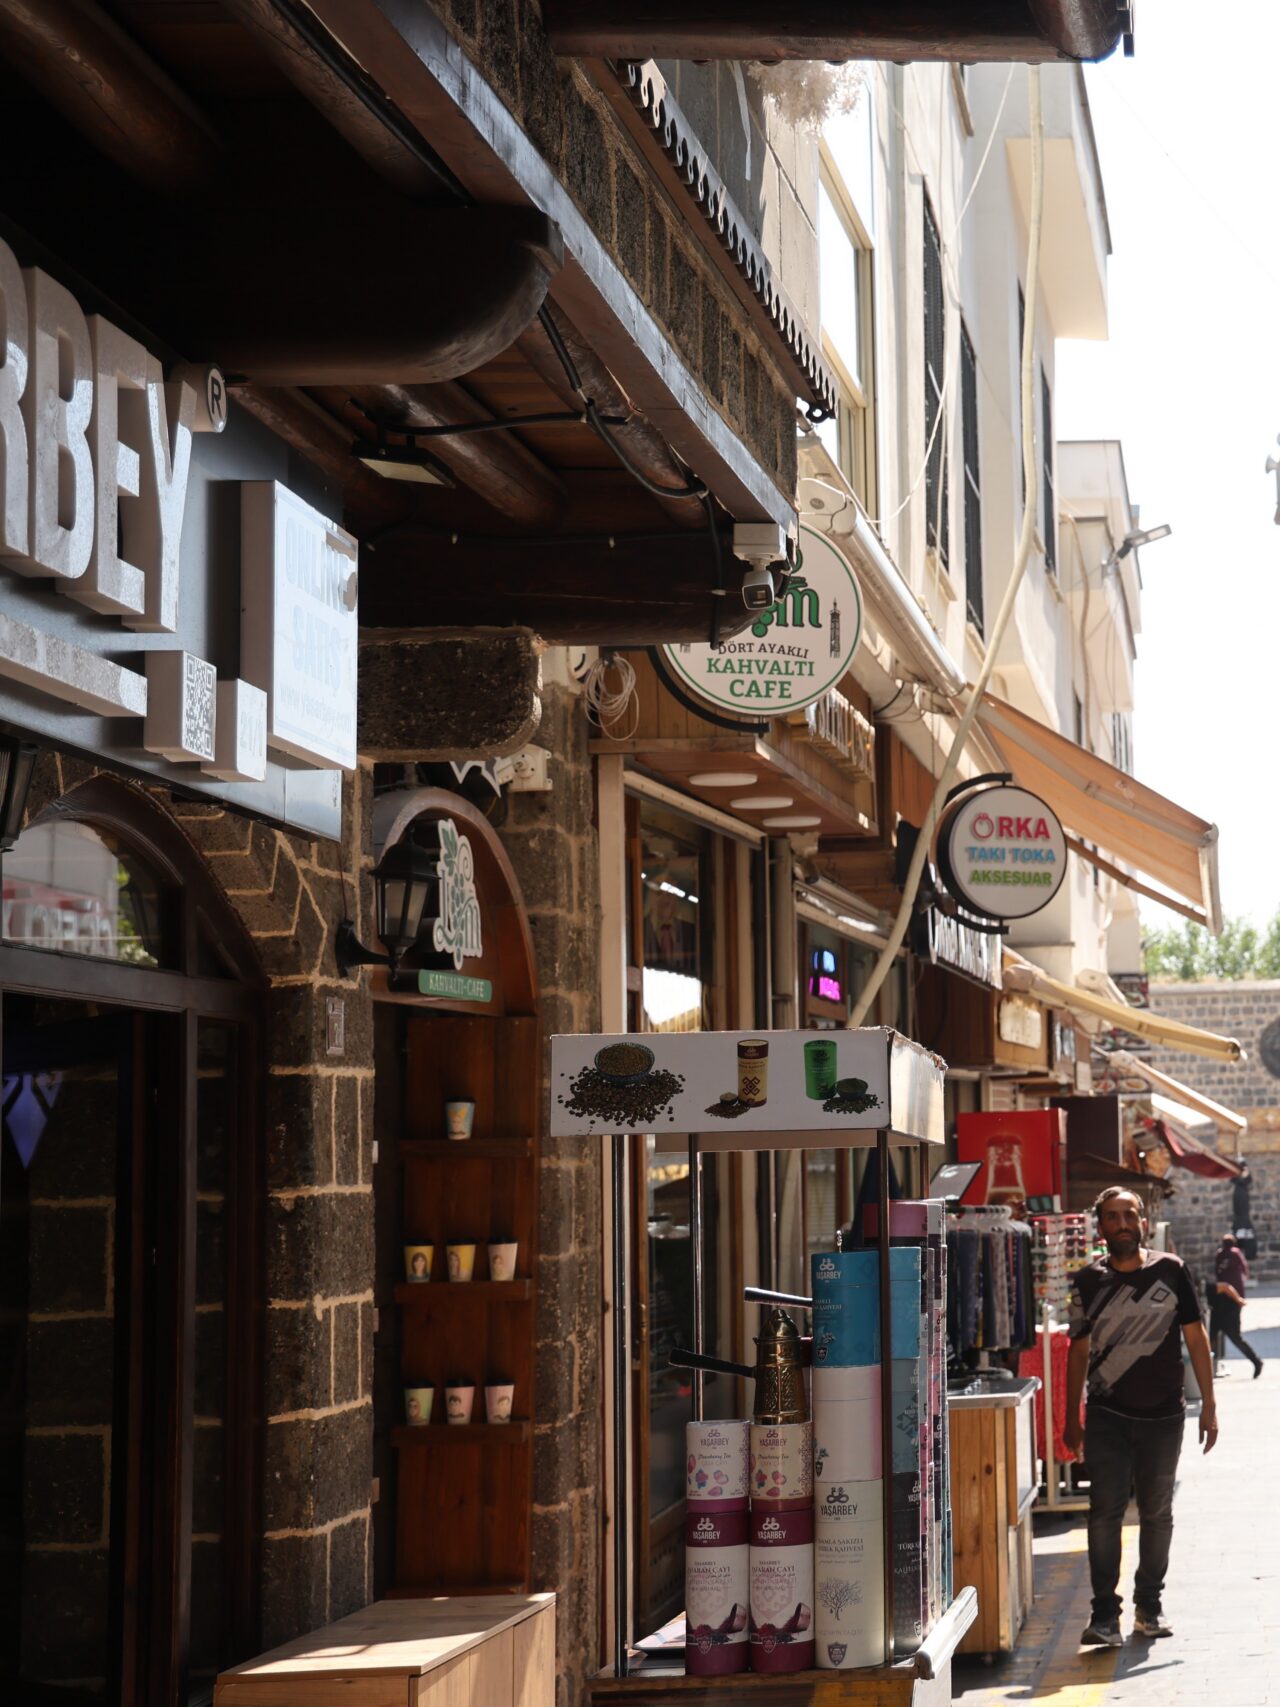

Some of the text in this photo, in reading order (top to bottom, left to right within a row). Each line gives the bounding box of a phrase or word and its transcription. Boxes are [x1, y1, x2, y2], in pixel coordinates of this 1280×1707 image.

[718, 641, 809, 659] DÖRT AYAKLI
[706, 658, 815, 676] KAHVALTI
[729, 679, 792, 698] CAFE
[967, 846, 1056, 864] TAKI TOKA
[969, 869, 1053, 886] AKSESUAR
[820, 1504, 857, 1517] YAŞARBEY
[692, 1530, 721, 1540] YAŞARBEY
[757, 1530, 786, 1540] YAŞARBEY
